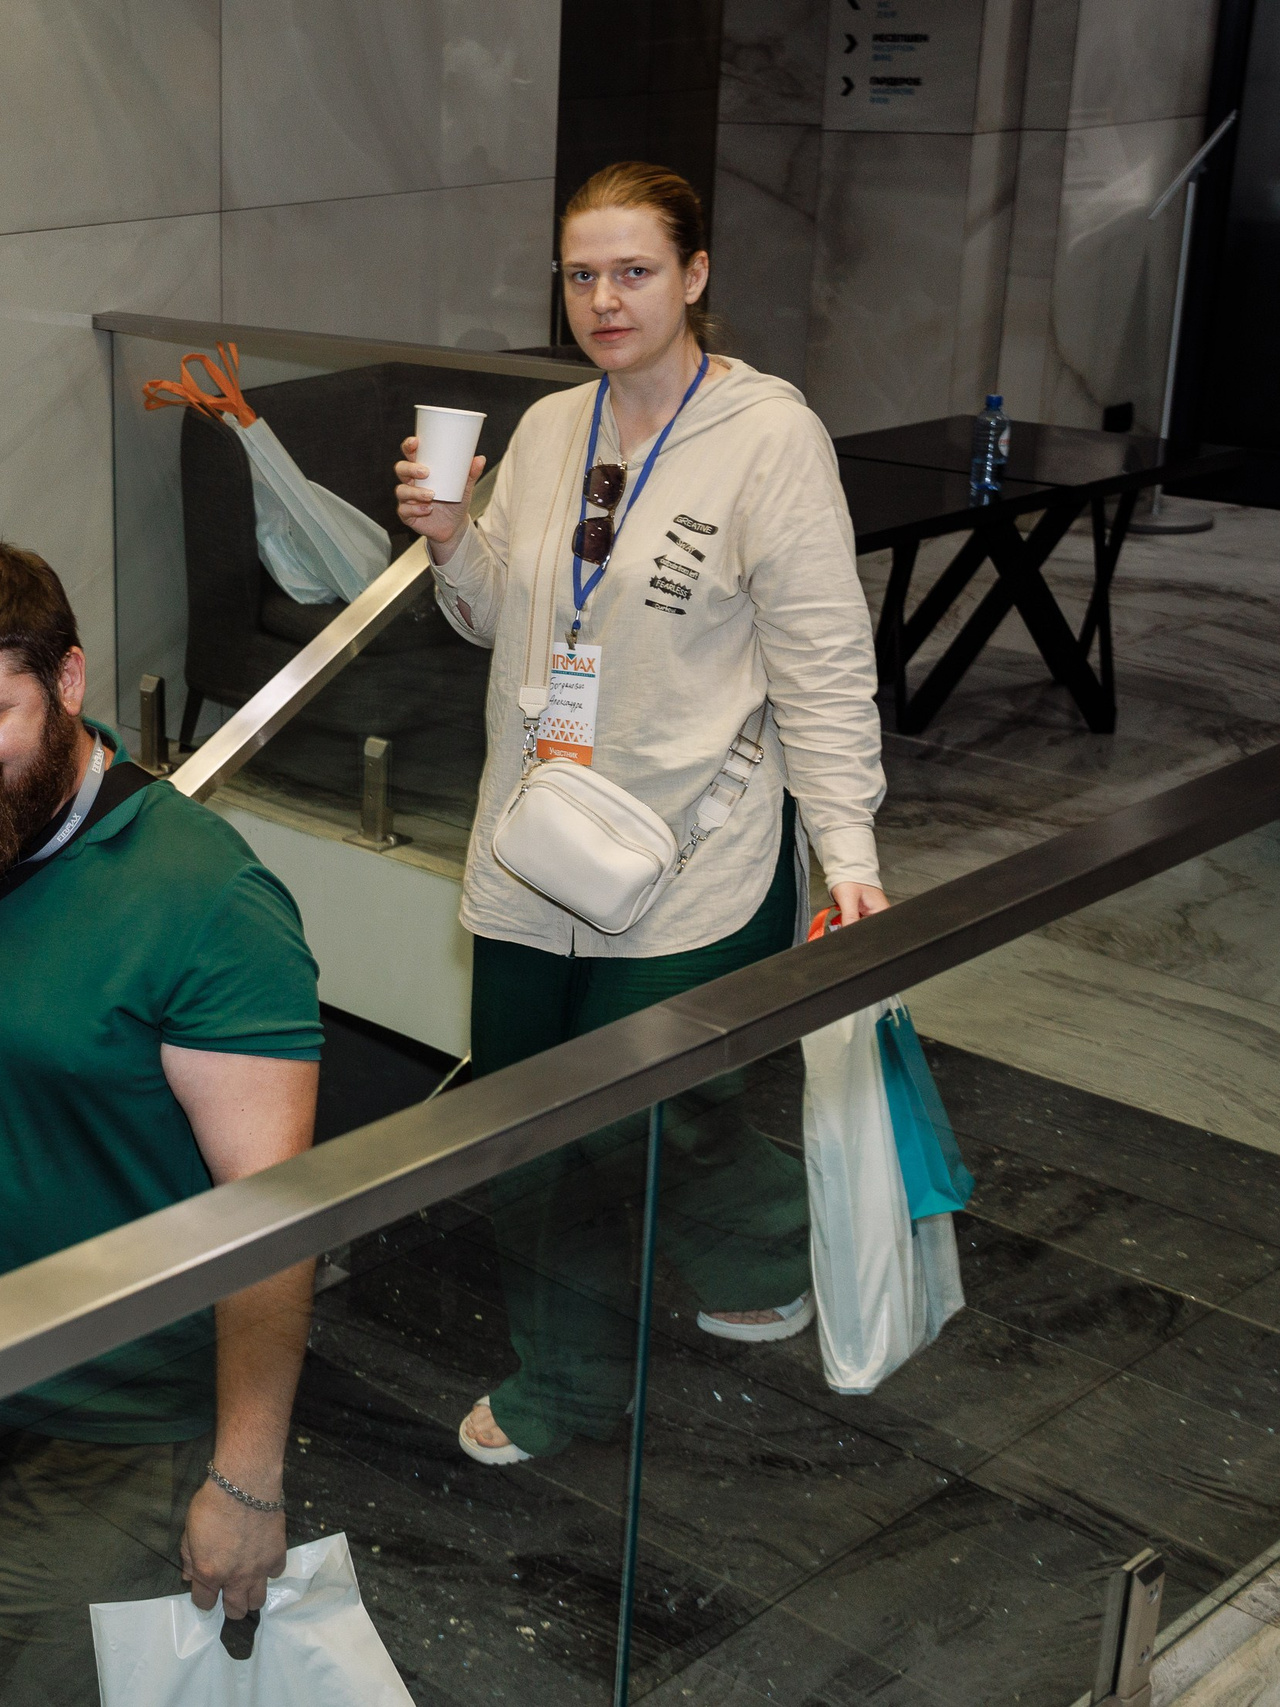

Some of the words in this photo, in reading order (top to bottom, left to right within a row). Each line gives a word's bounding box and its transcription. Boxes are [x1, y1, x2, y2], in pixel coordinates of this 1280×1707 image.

[655, 579, 688, 597] FEARLESS
[552, 654, 596, 673] IRMAX
[548, 746, 579, 759] Участник
[56, 812, 82, 843] FIRMAX
